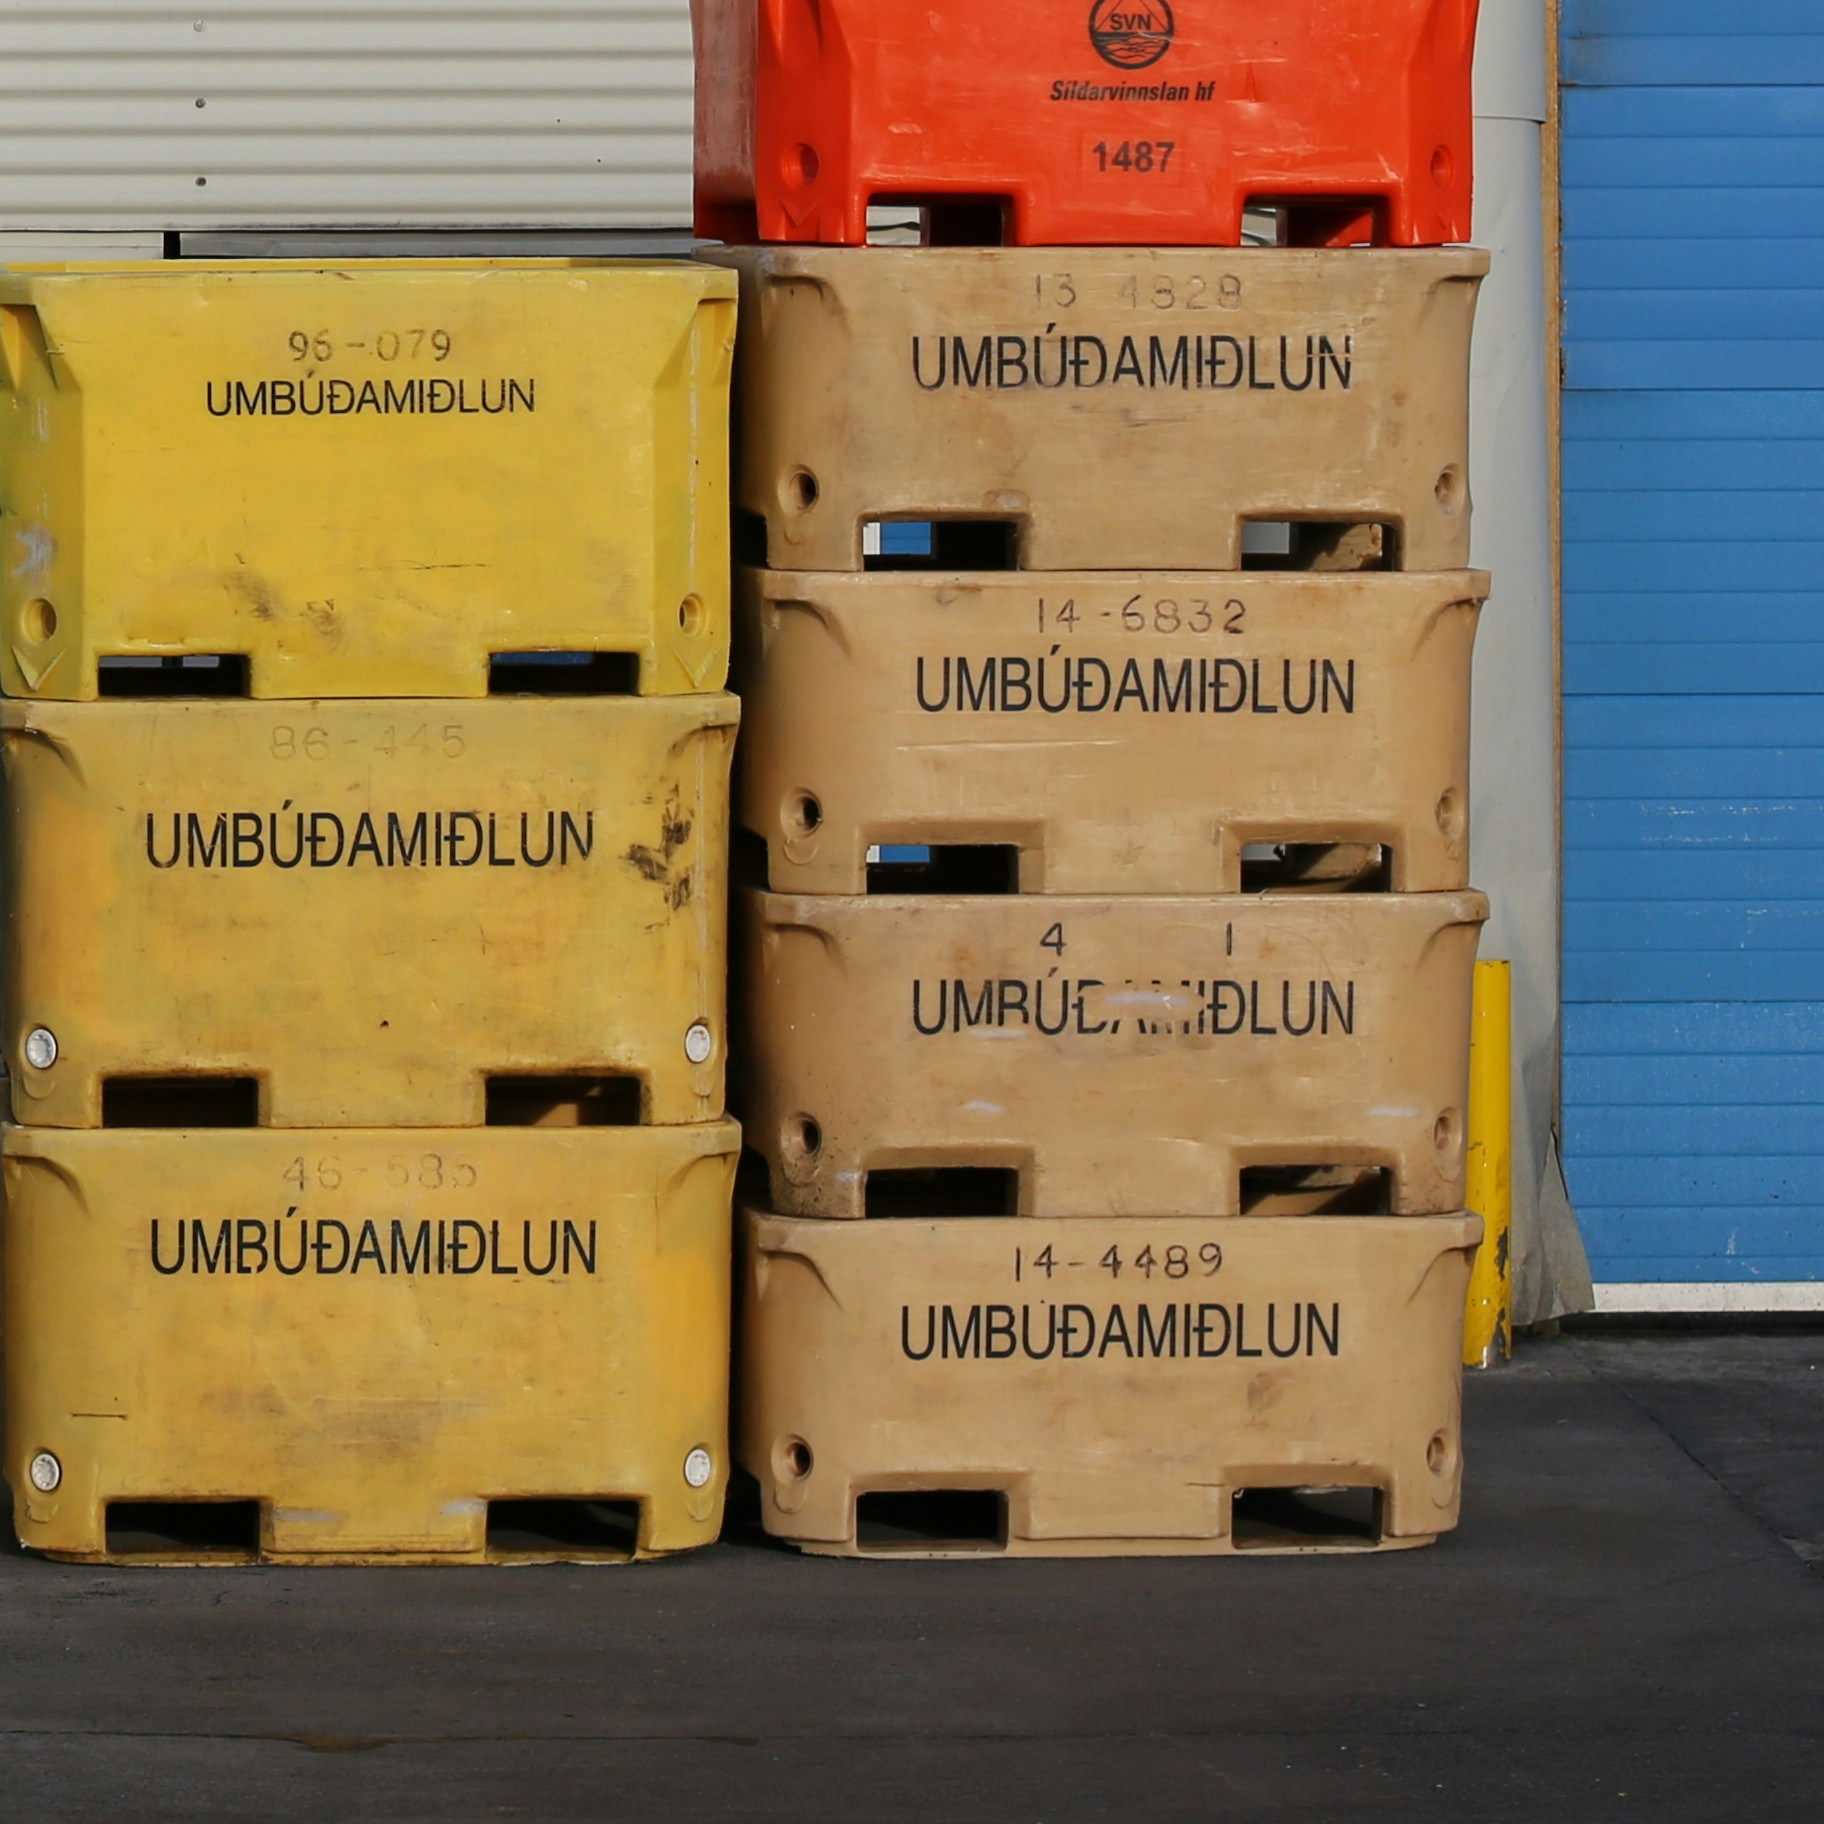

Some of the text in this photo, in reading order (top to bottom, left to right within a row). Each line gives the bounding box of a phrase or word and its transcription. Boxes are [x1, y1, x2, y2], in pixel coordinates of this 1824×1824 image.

[1109, 13, 1152, 31] SVN
[1050, 80, 1217, 102] Síldarvinnslan hf
[1092, 141, 1176, 173] 1487
[912, 322, 1353, 391] UMBÚÐAMIÐLUN
[207, 368, 535, 417] UMBÚÐAMIÐLUN
[917, 644, 1355, 714] UMBÚÐAMIÐLUN
[145, 799, 595, 869] UMBÚÐAMIÐLUN
[1039, 922, 1066, 957] 4
[151, 1206, 597, 1275] UMBÚÐAMIÐLUN
